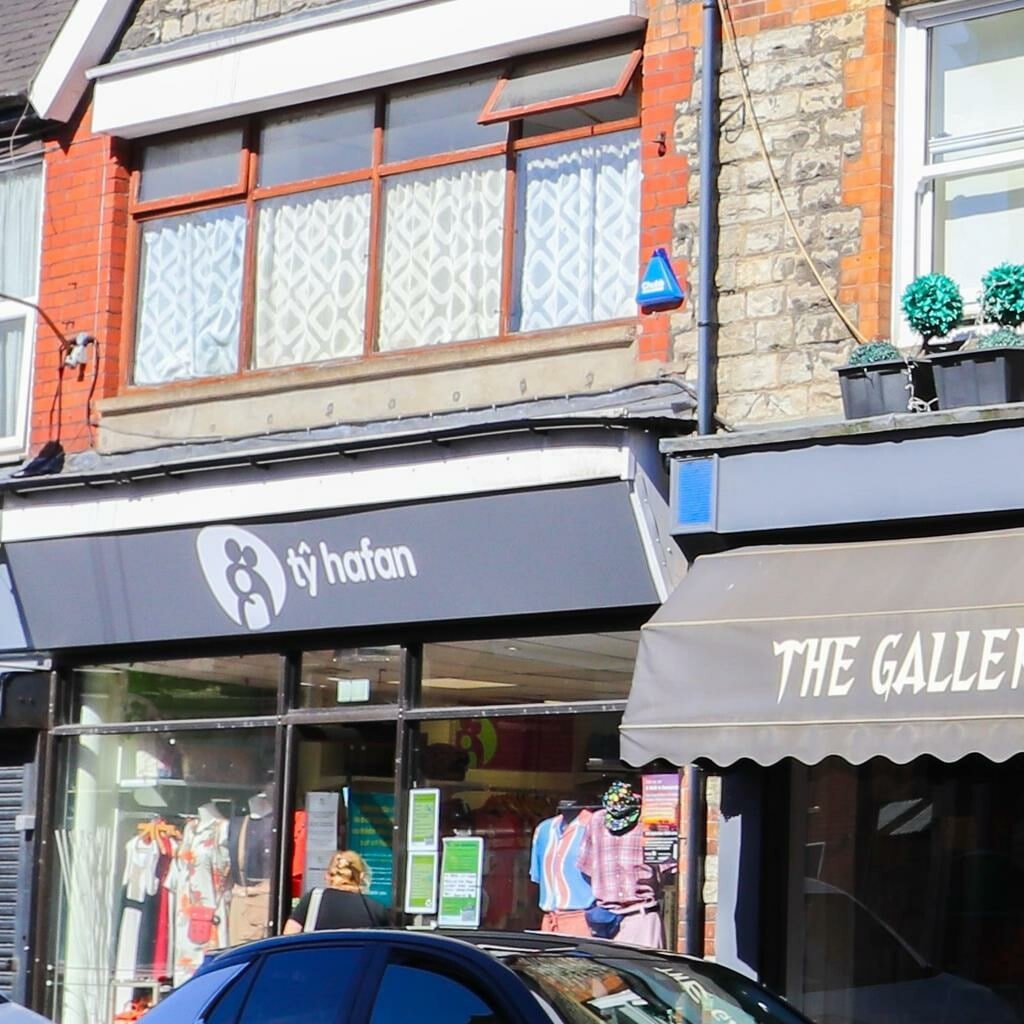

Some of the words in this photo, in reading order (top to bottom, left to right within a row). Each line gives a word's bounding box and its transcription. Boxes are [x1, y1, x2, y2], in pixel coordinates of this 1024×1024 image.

[287, 541, 317, 597] tŷ
[319, 537, 417, 584] hafan
[773, 636, 861, 704] THE
